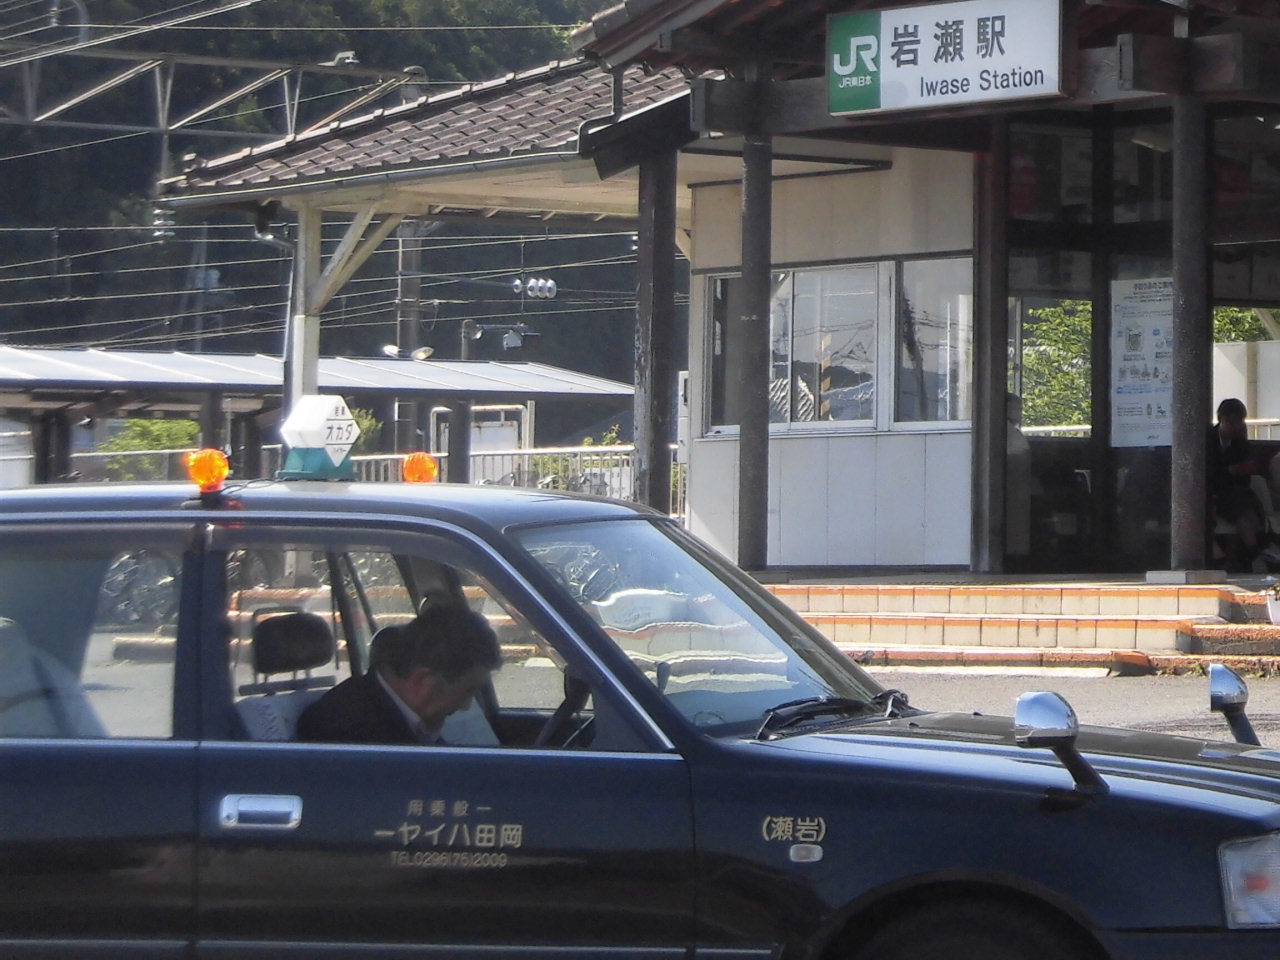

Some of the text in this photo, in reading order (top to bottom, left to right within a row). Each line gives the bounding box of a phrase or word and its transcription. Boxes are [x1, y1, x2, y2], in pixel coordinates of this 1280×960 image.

[833, 35, 878, 75] JR
[890, 15, 1007, 69] 岩瀬駅
[920, 66, 1044, 97] Iwase Station
